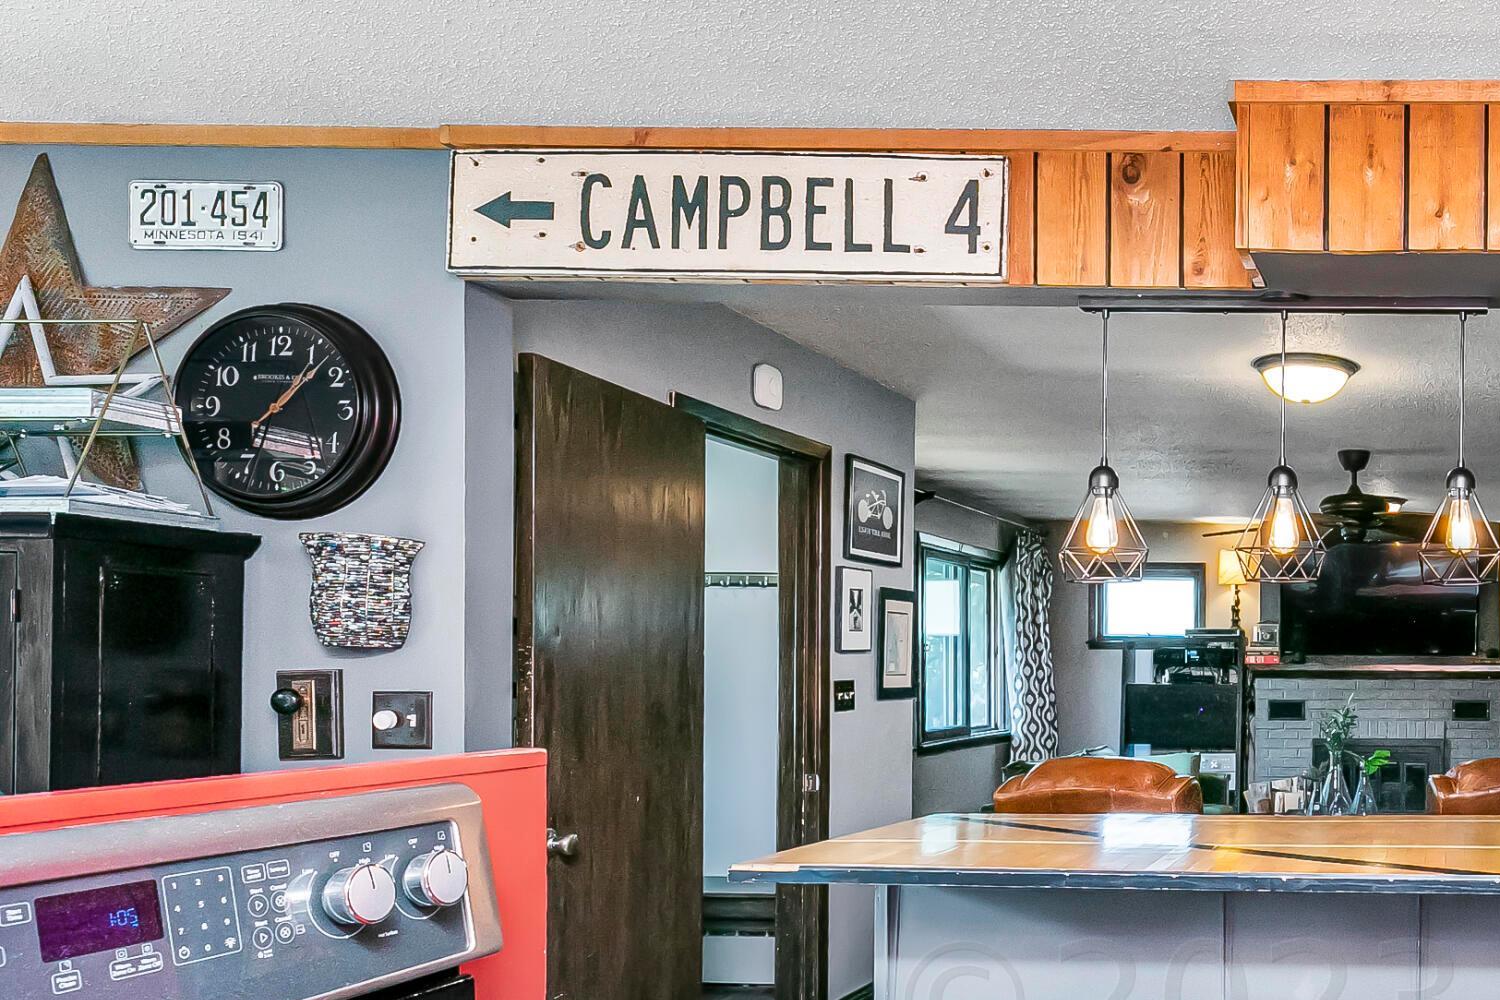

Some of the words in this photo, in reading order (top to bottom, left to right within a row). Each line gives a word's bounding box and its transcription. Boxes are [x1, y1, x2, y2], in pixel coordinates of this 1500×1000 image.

[580, 173, 911, 254] CAMPBELL
[944, 178, 982, 254] 4
[144, 230, 225, 240] MINNESOTA
[232, 230, 264, 241] 1941
[239, 341, 257, 363] 11
[269, 335, 294, 357] 12
[306, 344, 315, 365] 1
[215, 365, 240, 387] 10
[328, 366, 346, 388] 2
[205, 395, 221, 417] 9
[336, 400, 354, 421] 3
[217, 427, 231, 449] 8
[325, 431, 340, 454] 4
[240, 453, 256, 475] 7
[269, 461, 285, 482] 6
